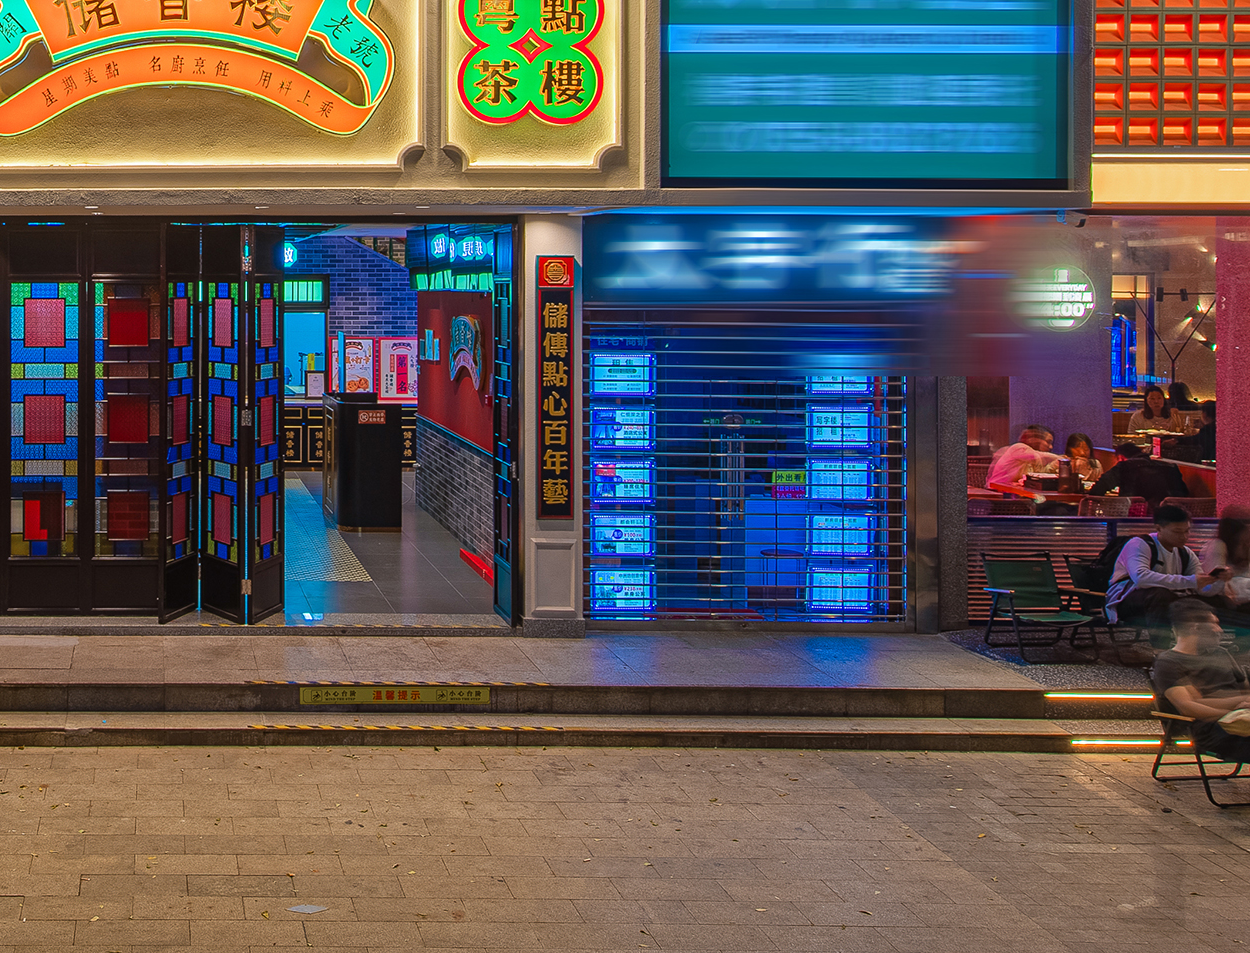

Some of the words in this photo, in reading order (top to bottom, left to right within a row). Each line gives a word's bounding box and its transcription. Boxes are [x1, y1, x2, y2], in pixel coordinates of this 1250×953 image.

[324, 14, 379, 68] 老號
[473, 59, 586, 106] 茶樓
[542, 302, 569, 506] 儲傳點心百年藝
